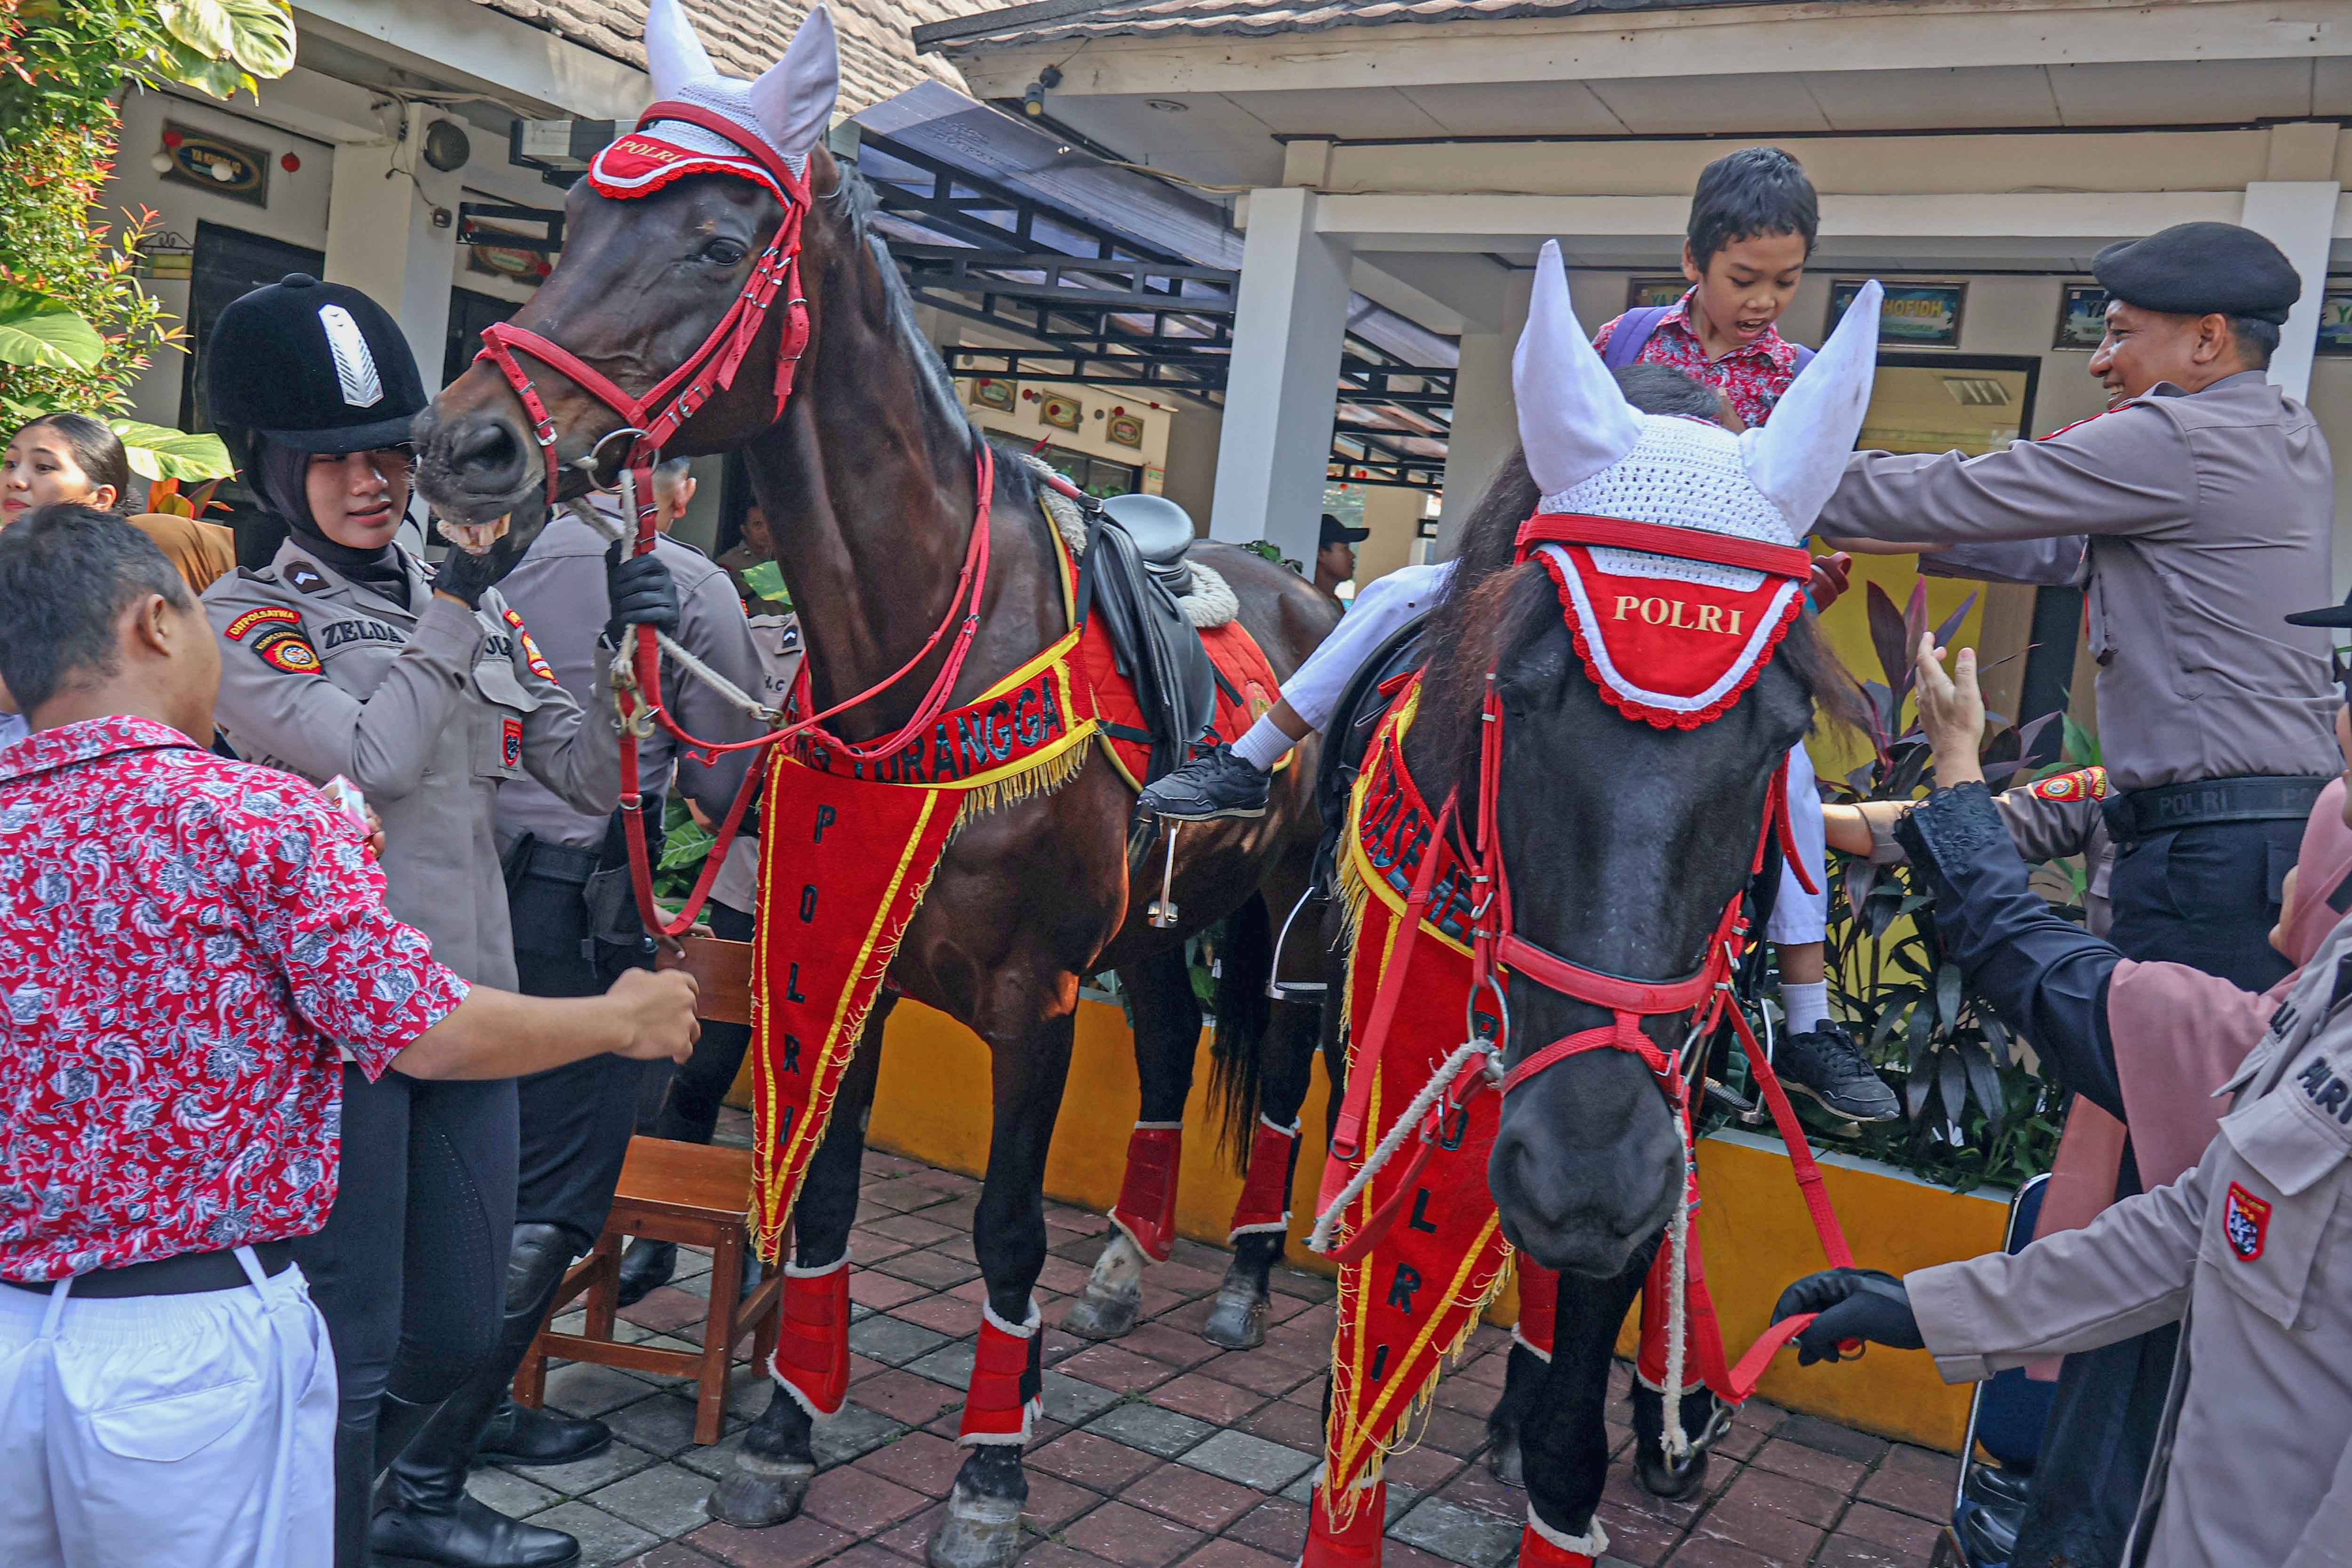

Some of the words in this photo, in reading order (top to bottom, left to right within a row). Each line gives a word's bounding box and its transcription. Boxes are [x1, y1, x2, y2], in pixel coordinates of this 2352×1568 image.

[613, 141, 684, 163] POLRI
[229, 610, 295, 635] DITPOLSATWA
[1611, 596, 1745, 636] POLRI
[321, 620, 406, 649] ZELDA
[2159, 788, 2229, 815] POLRI
[779, 803, 836, 1145] POLRI
